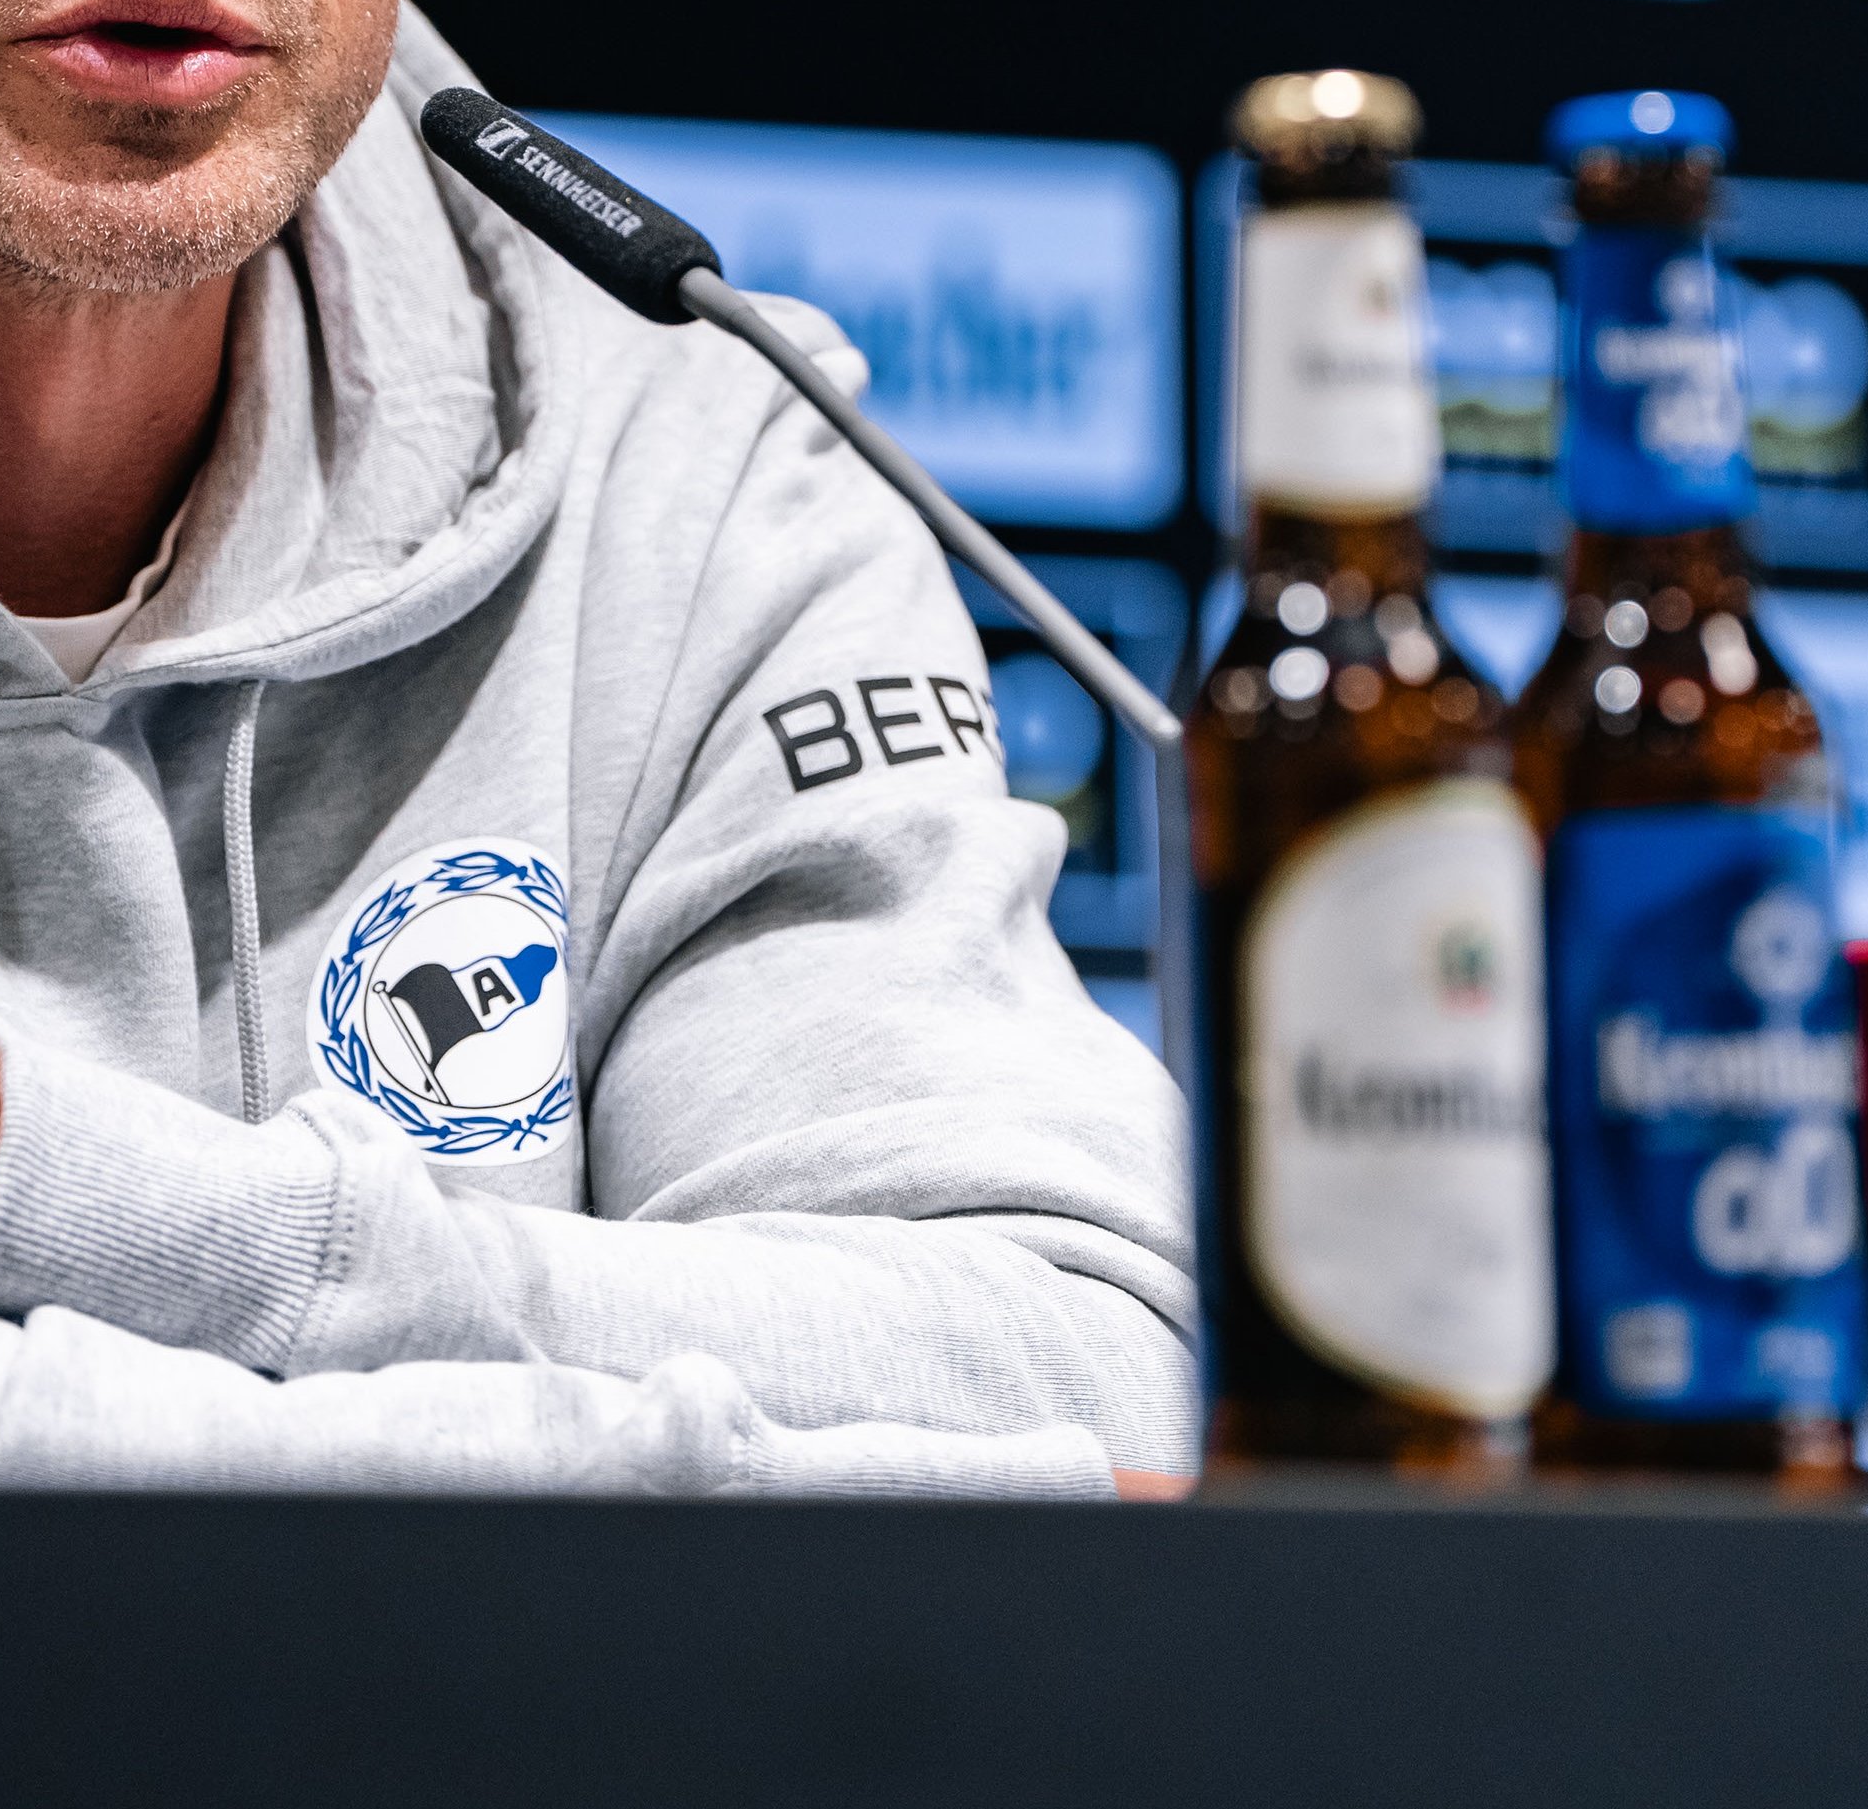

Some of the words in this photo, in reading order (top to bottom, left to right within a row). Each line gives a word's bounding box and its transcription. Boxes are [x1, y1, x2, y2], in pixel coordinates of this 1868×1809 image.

[513, 144, 645, 239] SENNHEISER
[762, 676, 991, 793] BER
[472, 967, 516, 1017] A
